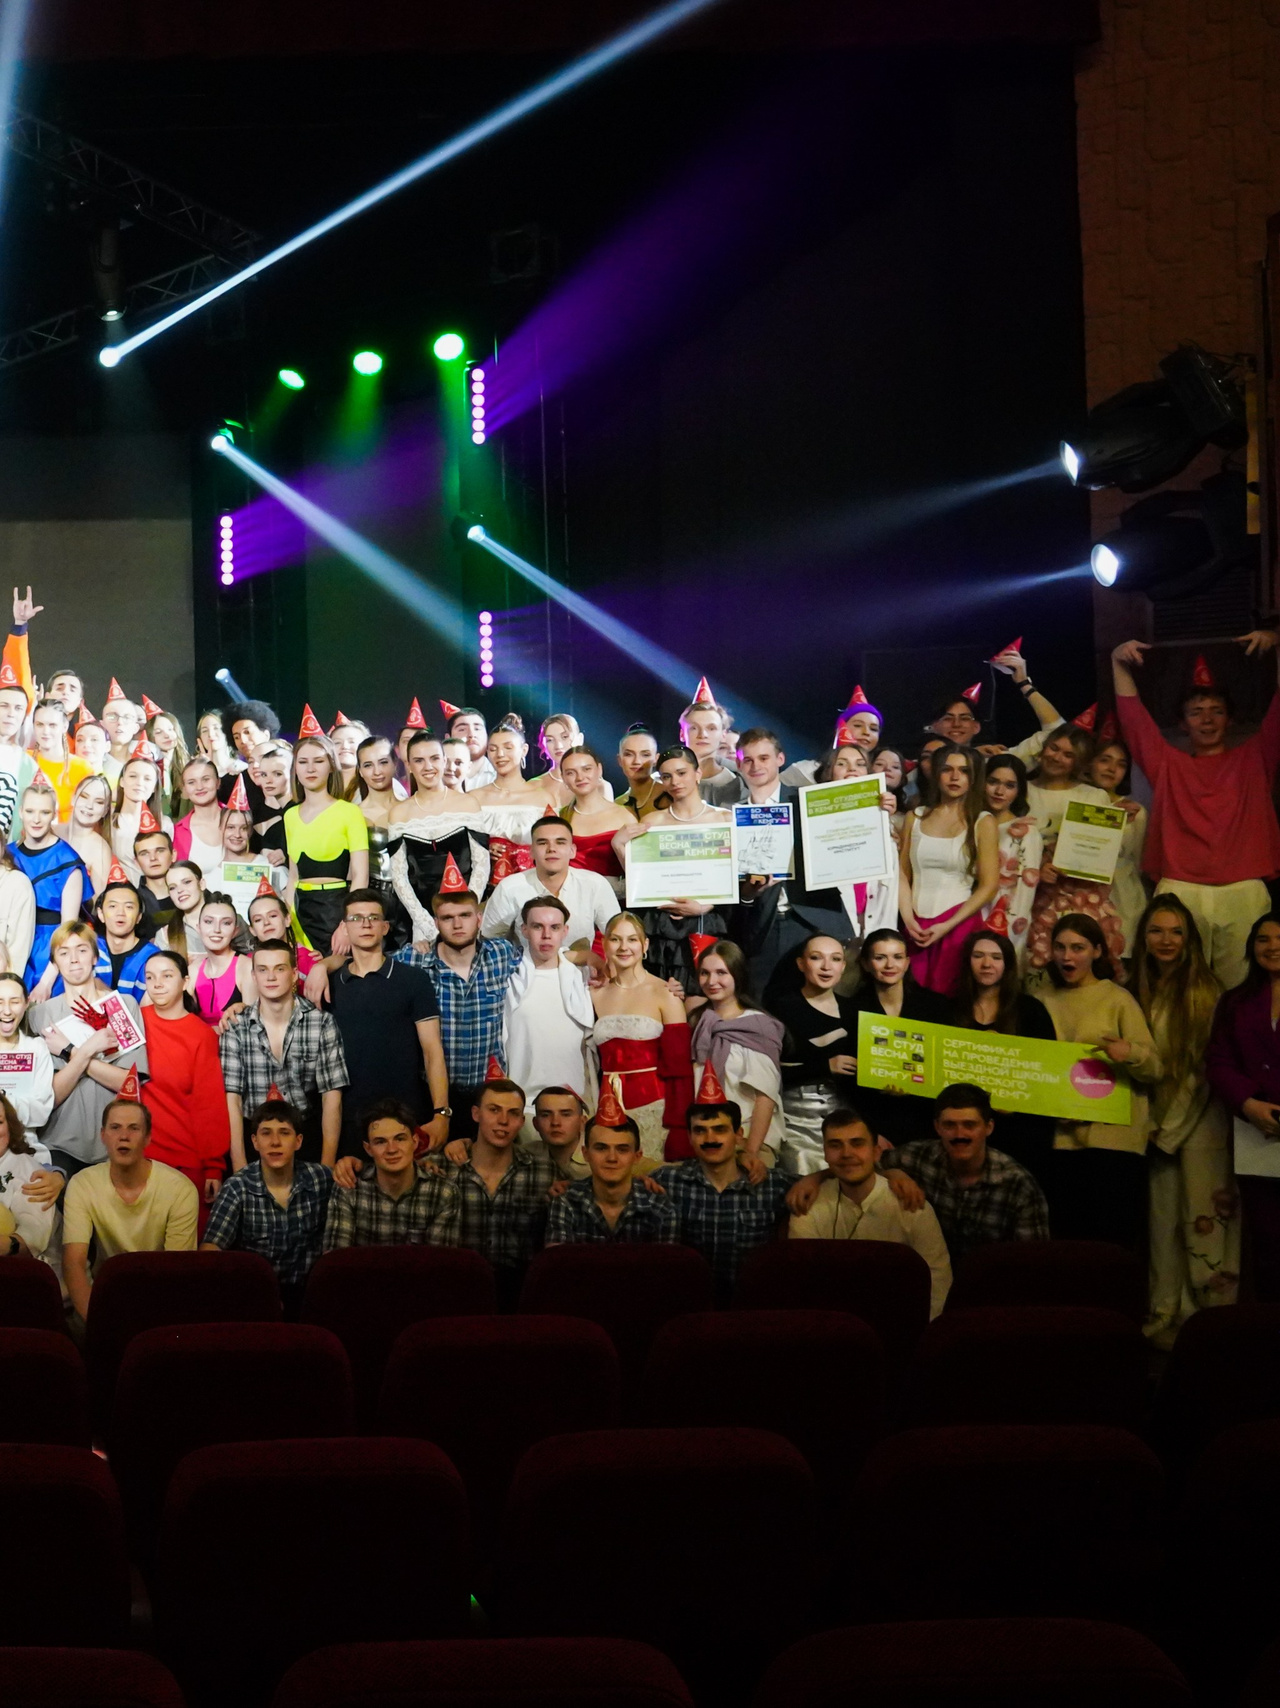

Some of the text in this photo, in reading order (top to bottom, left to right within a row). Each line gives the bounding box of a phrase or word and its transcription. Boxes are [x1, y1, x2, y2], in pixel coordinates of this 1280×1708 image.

[704, 831, 730, 840] СТУД
[659, 842, 690, 850] ВЕСНА
[684, 848, 716, 856] КЕМГУ
[870, 1046, 908, 1060] ВЕСНА
[894, 1040, 924, 1054] СТУД
[943, 1038, 1022, 1056] СЕРТИФИКАТ
[943, 1049, 1042, 1071] НА ПРОВЕДЕНИЕ
[870, 1067, 908, 1080] КЕМГУ
[916, 1064, 924, 1074] В
[943, 1059, 1010, 1076] ВЫЕЗДНОЙ
[1012, 1069, 1060, 1084] ШКОЛЫ
[943, 1070, 1027, 1090] ТВОРЧЕСКОГО
[991, 1088, 1030, 1100] КЕМГУ
